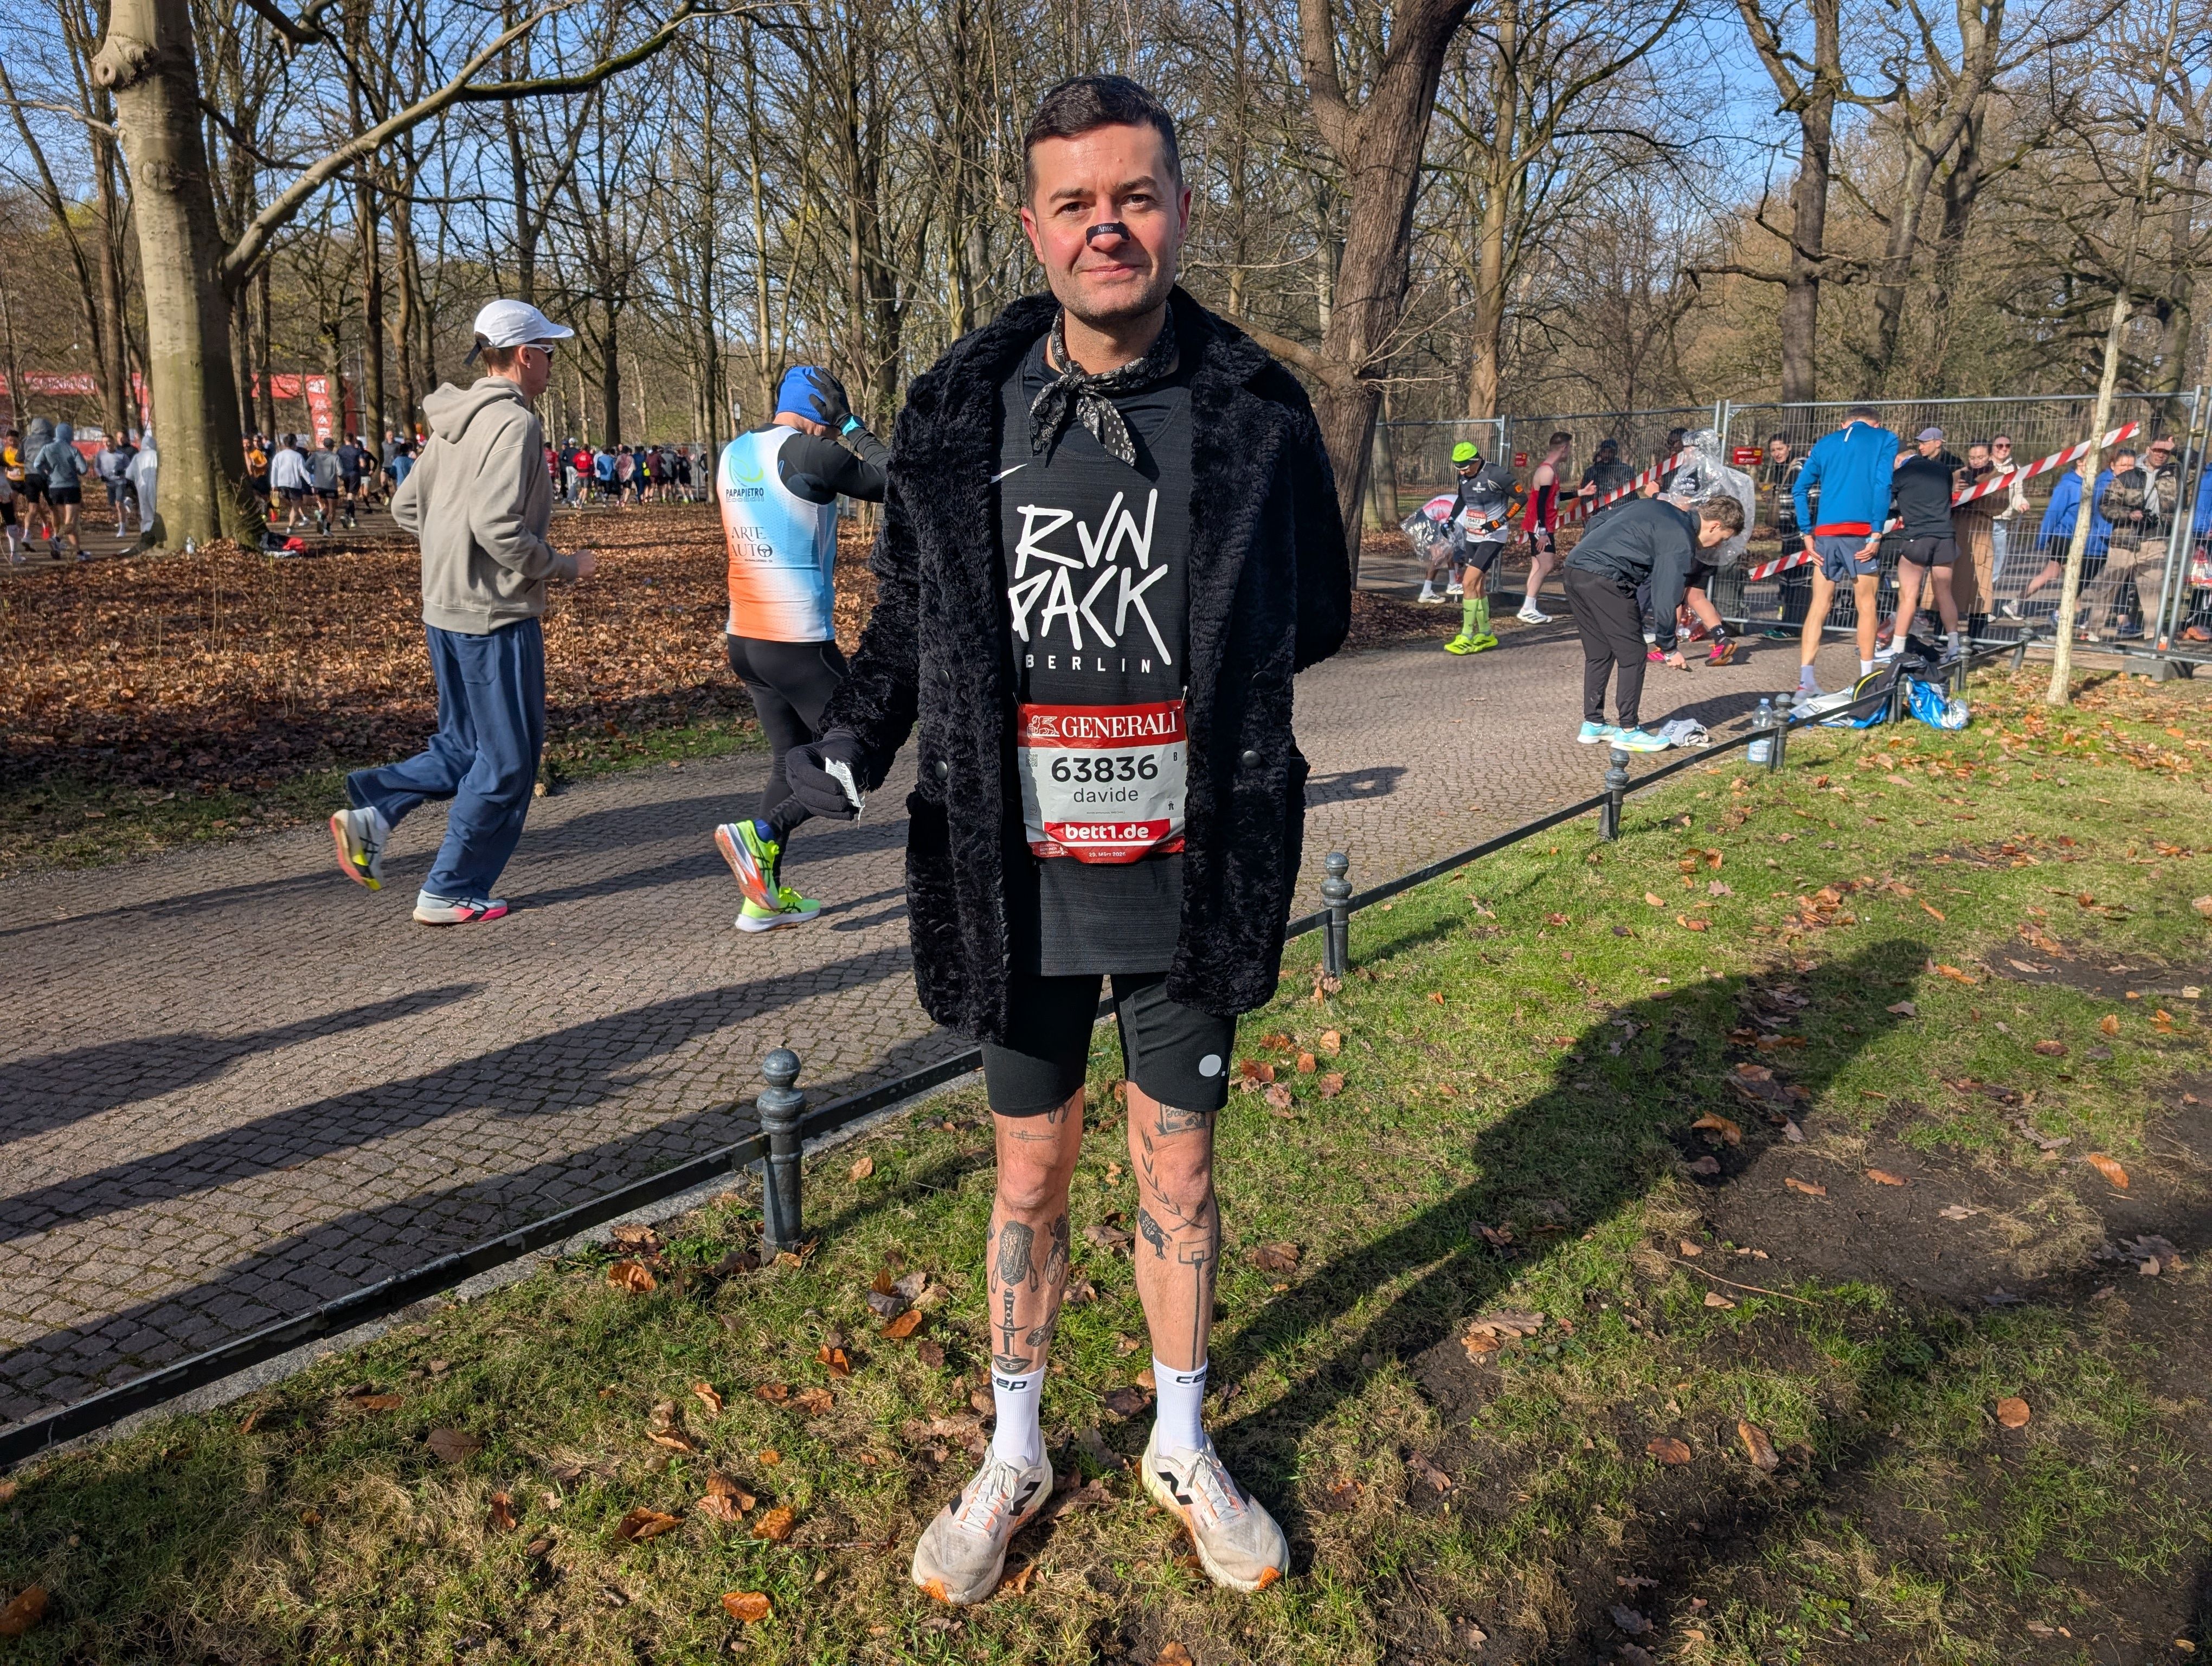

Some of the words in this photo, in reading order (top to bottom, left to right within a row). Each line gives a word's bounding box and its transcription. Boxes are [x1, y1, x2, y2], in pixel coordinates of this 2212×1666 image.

[726, 488, 764, 497] PAPAPIETRO
[731, 526, 767, 542] ARTE
[1008, 563, 1172, 665] PACK
[1025, 654, 1150, 674] BERLIN
[1061, 711, 1178, 739] GENERALI
[1173, 752, 1178, 761] B
[1051, 754, 1158, 782] 63836
[1073, 786, 1139, 803] davide
[1065, 824, 1149, 840] bett1.de
[1141, 1220, 1155, 1237] STEP
[1144, 1215, 1155, 1228] OUT
[1176, 1371, 1206, 1384] ce
